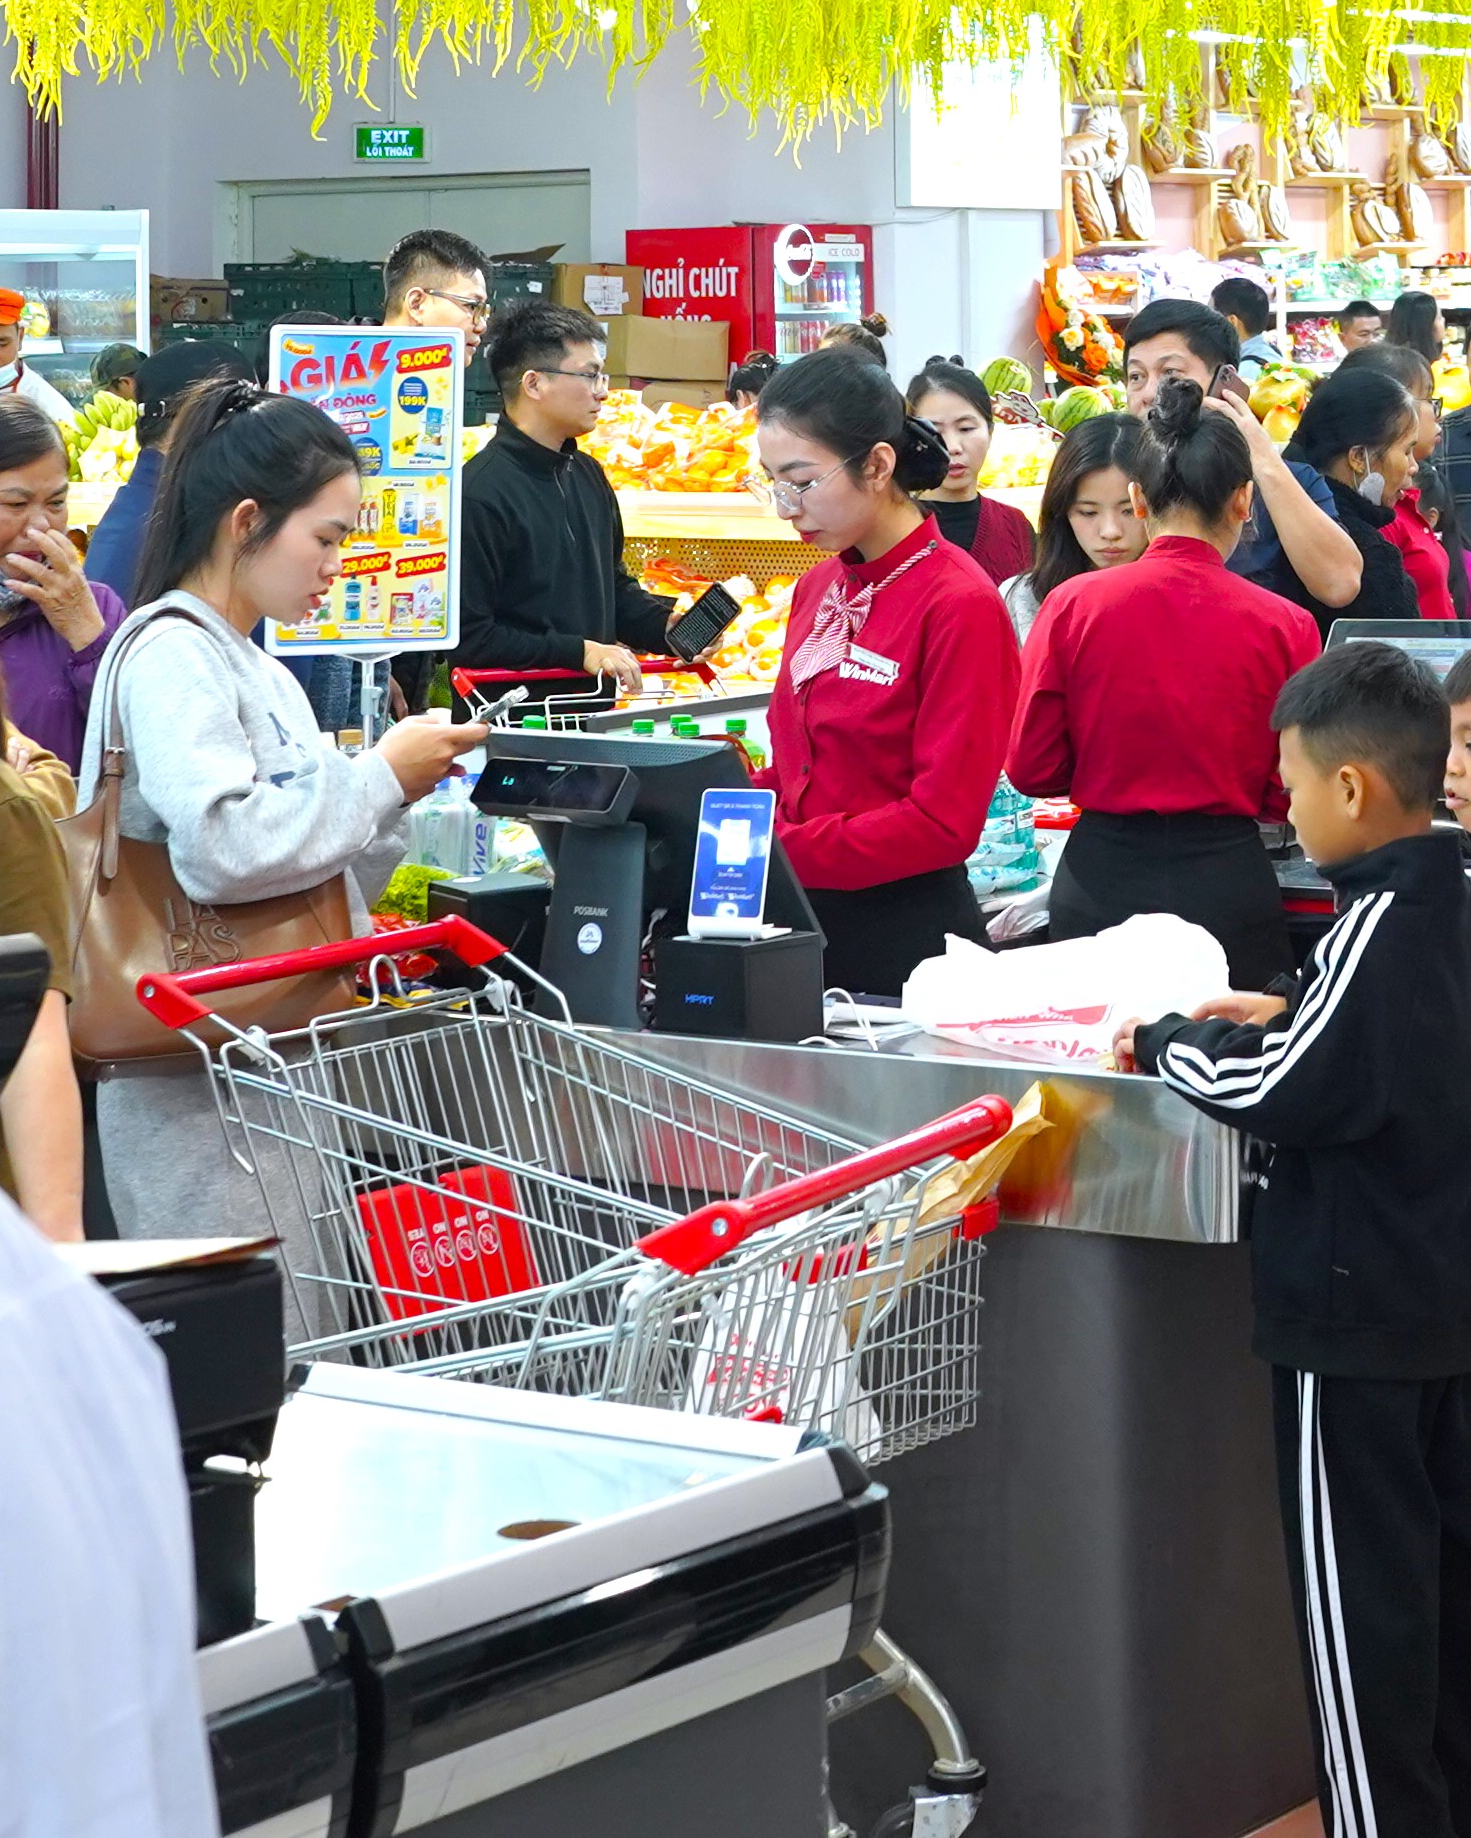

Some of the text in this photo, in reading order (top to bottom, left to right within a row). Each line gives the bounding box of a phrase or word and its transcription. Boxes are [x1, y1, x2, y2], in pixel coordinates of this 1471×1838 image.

[370, 129, 410, 144] EXIT
[384, 144, 414, 157] THOÁT
[828, 247, 860, 258] ICE COLD
[644, 257, 739, 299] NGHỈ CHÚT
[291, 341, 368, 393] GIÁ
[839, 661, 895, 687] WinMart
[574, 905, 609, 917] POSBANK
